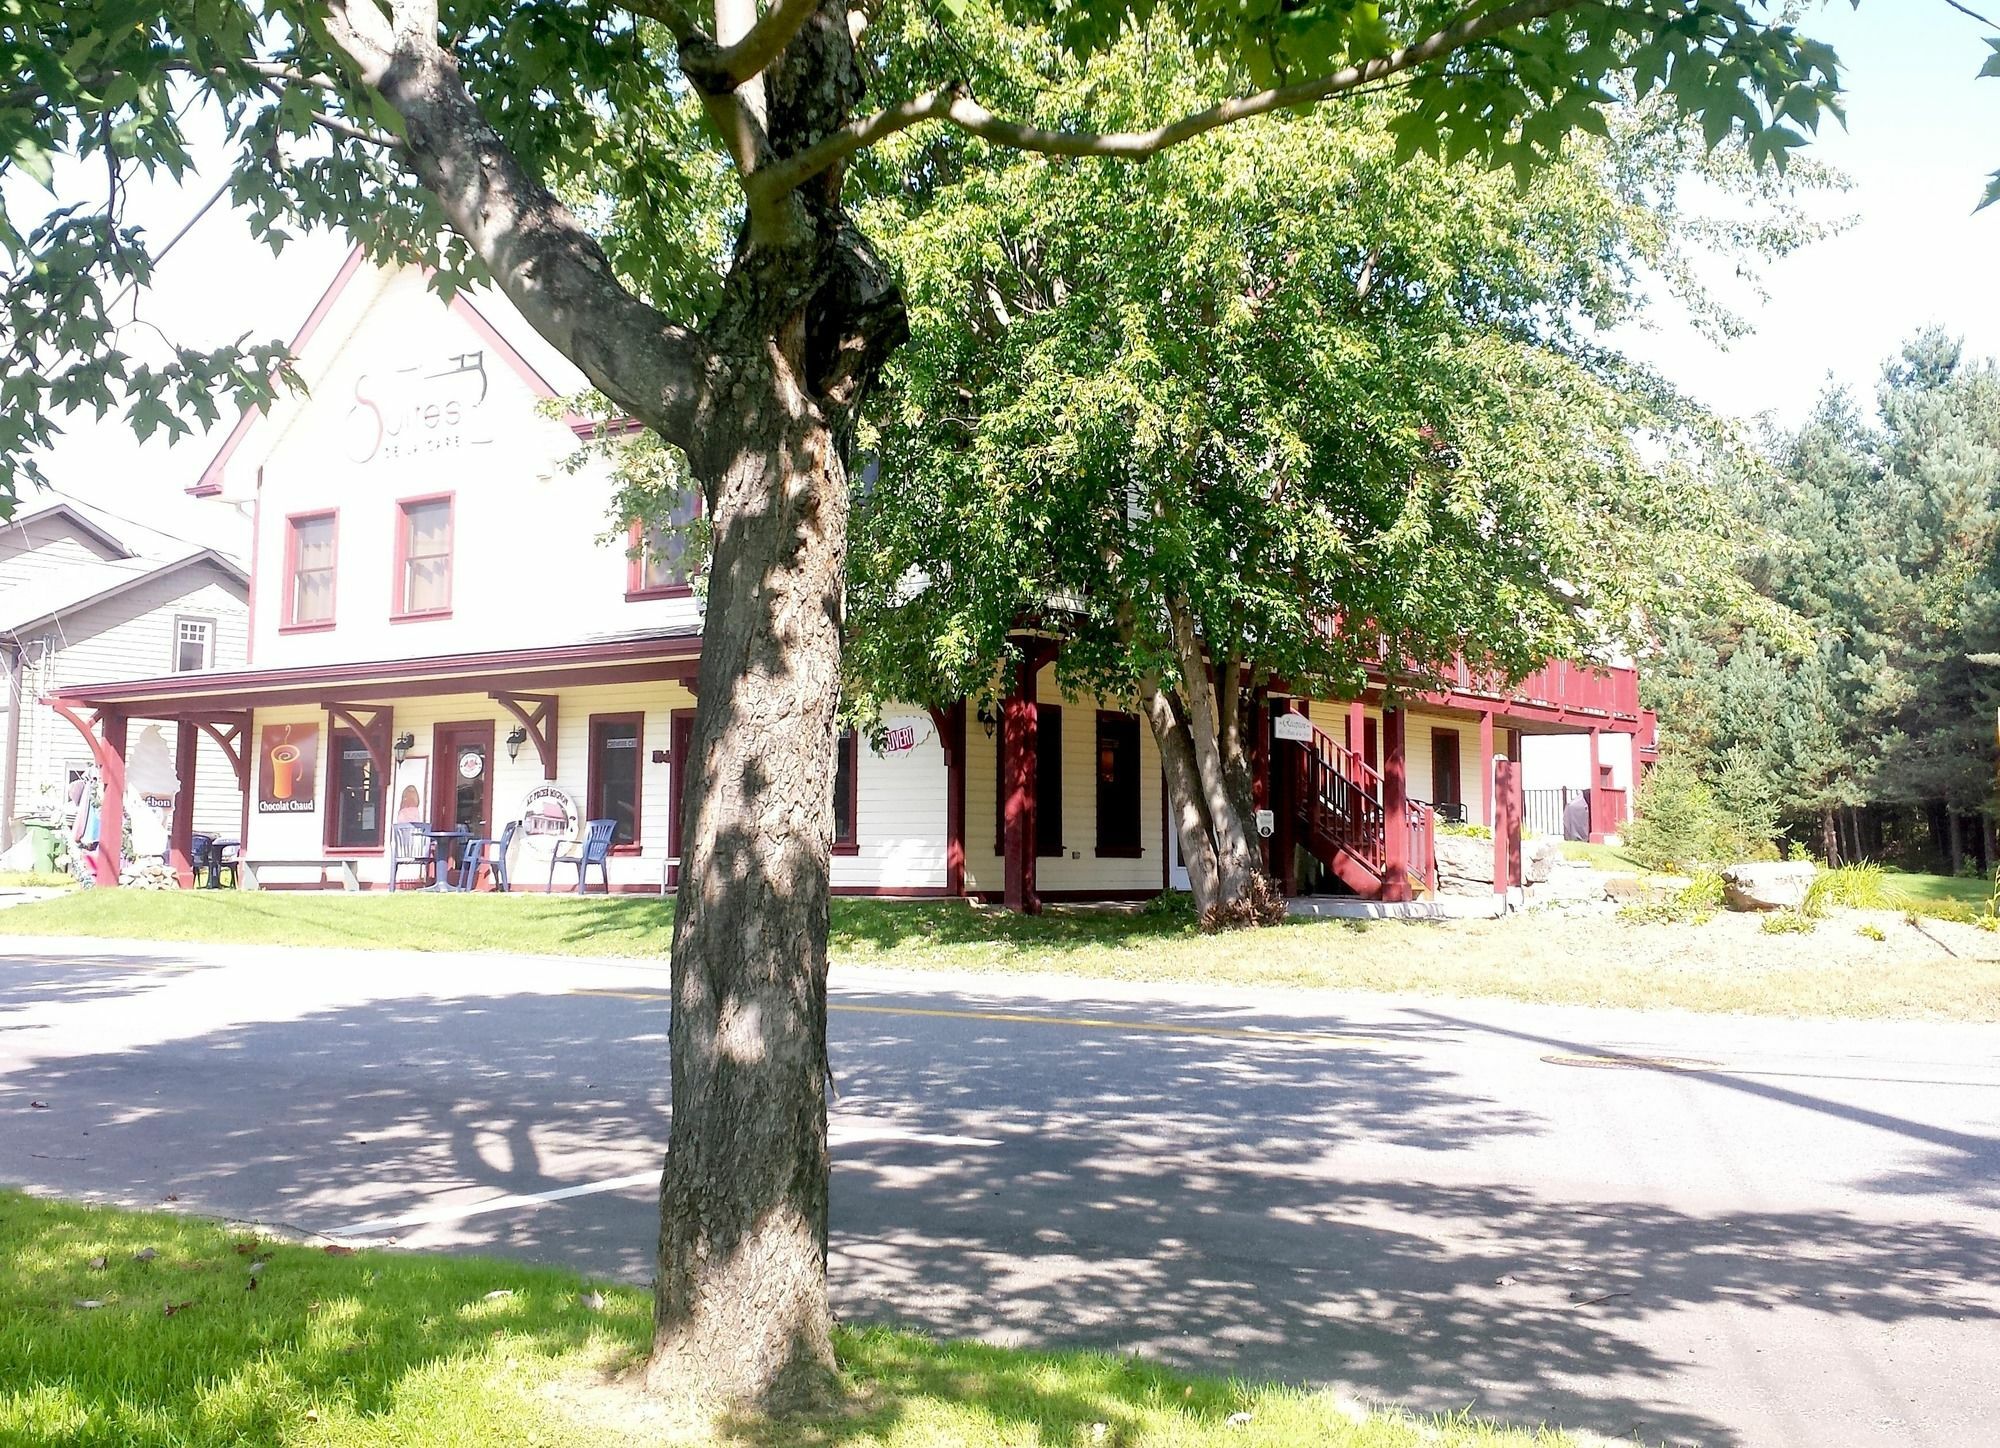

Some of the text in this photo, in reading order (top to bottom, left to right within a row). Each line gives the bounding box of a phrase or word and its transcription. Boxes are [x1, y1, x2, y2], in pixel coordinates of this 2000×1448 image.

[884, 726, 914, 752] UVERT
[259, 799, 314, 811] Chocolat Chaud
